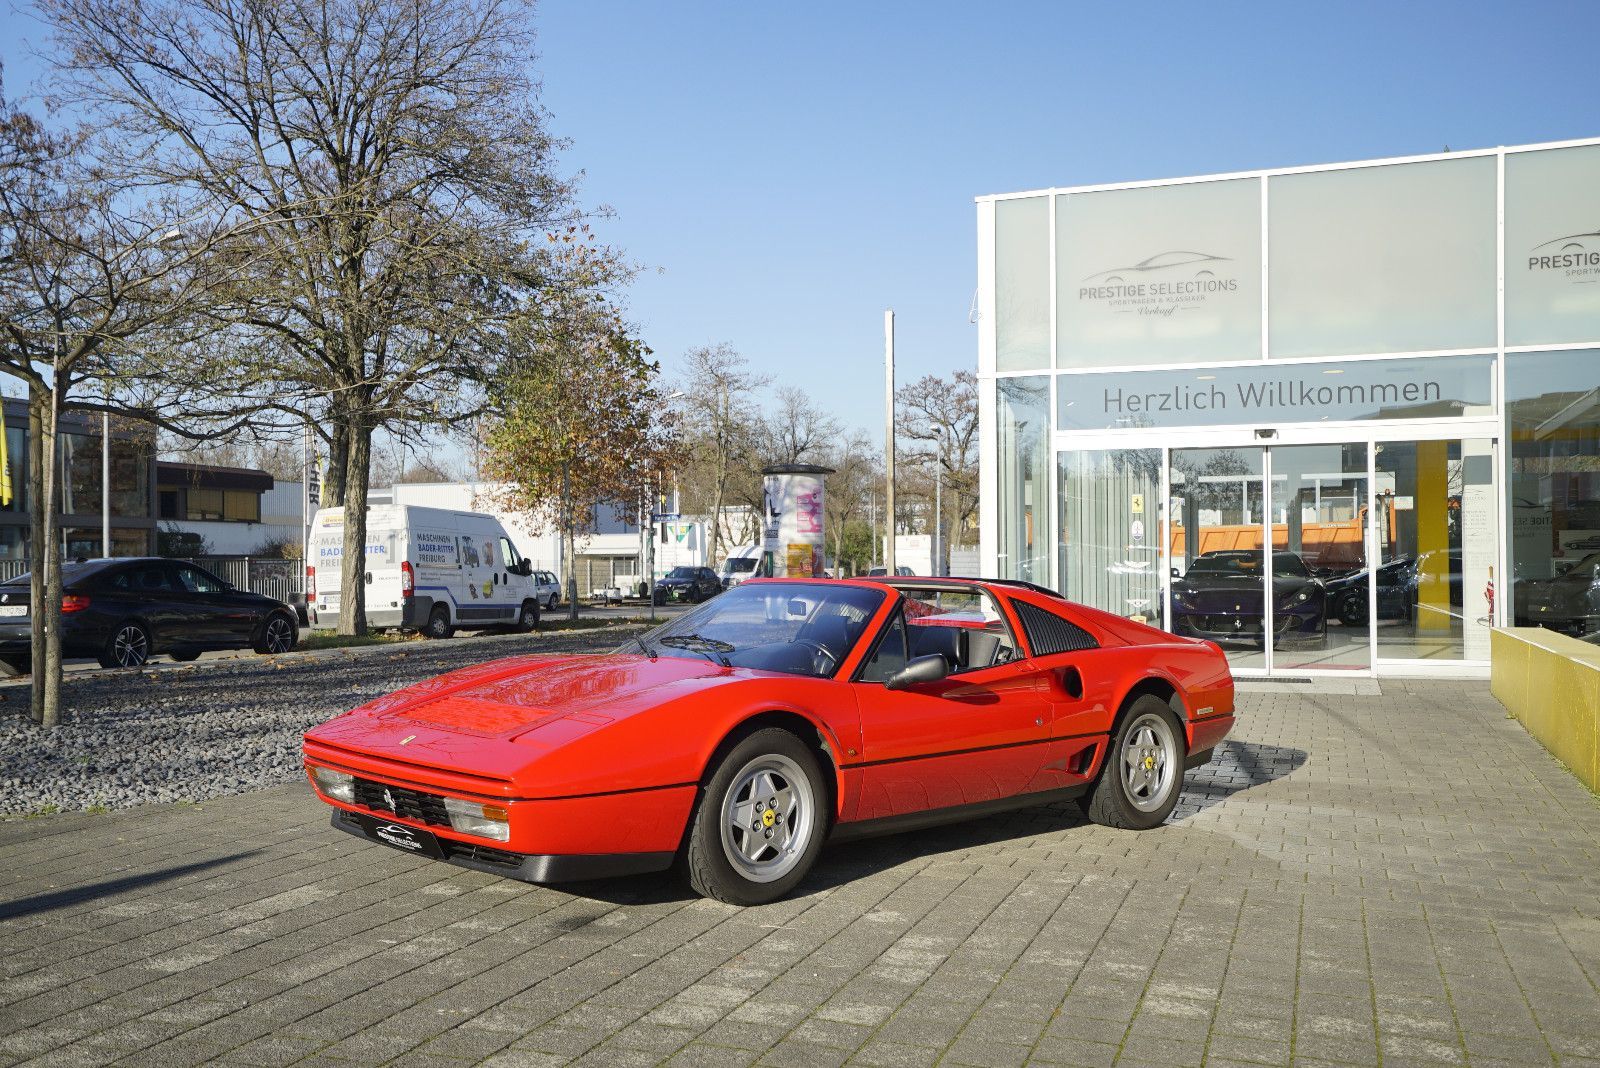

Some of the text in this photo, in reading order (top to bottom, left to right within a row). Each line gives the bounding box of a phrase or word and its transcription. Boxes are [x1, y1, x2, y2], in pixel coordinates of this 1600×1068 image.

[1079, 279, 1238, 300] PRESTIGE SELECTIONS
[1104, 380, 1442, 413] Herzlich Willkommen
[320, 535, 380, 546] MASEN
[416, 532, 451, 543] MASCHINEN
[418, 553, 446, 563] FREIBURG
